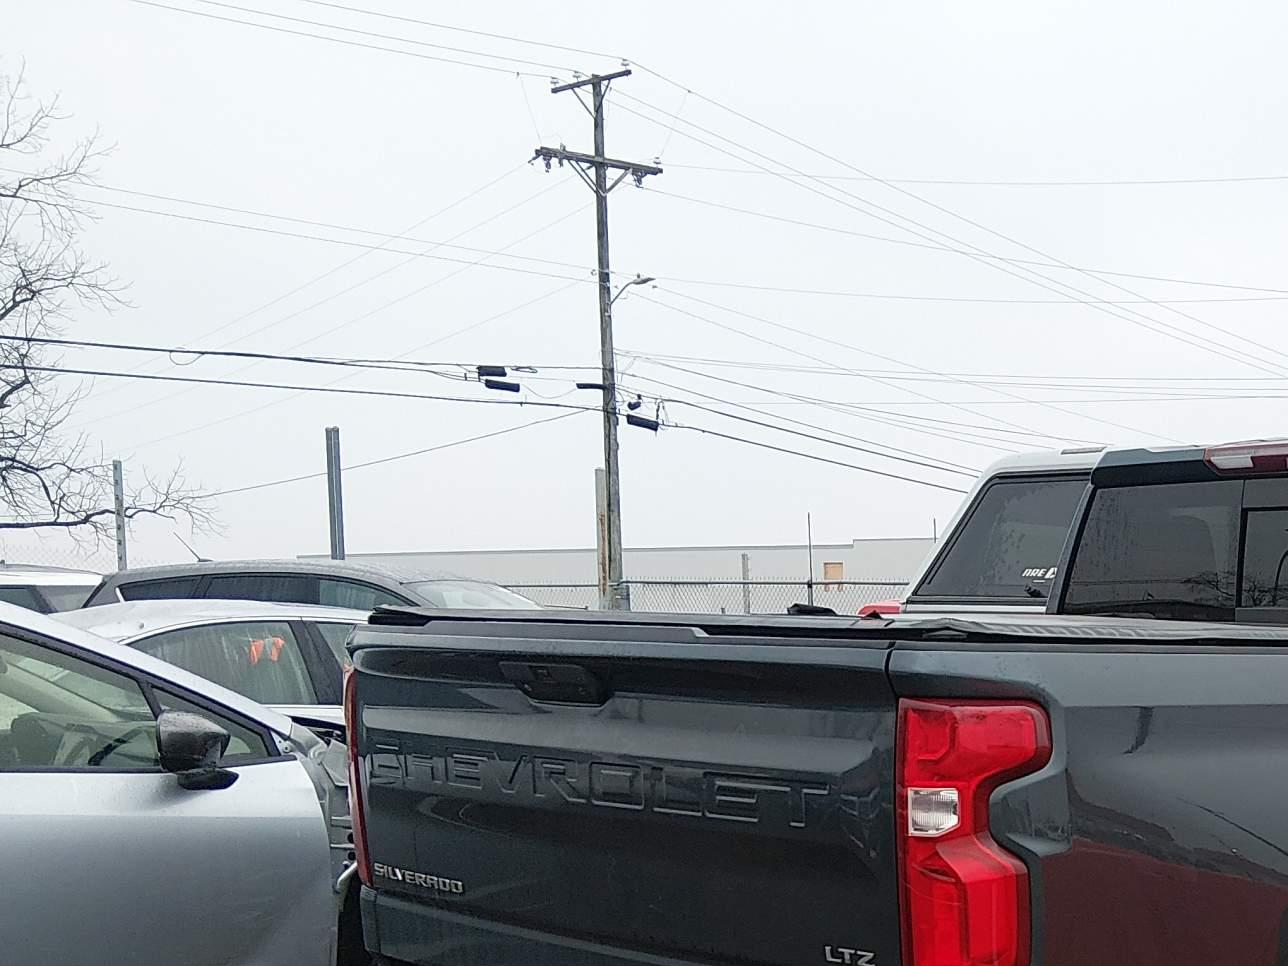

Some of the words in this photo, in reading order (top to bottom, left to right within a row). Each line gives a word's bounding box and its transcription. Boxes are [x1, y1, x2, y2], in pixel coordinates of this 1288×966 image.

[368, 741, 831, 828] CHEVROLET
[374, 862, 463, 893] SILVERADO
[825, 946, 876, 966] LTZ
